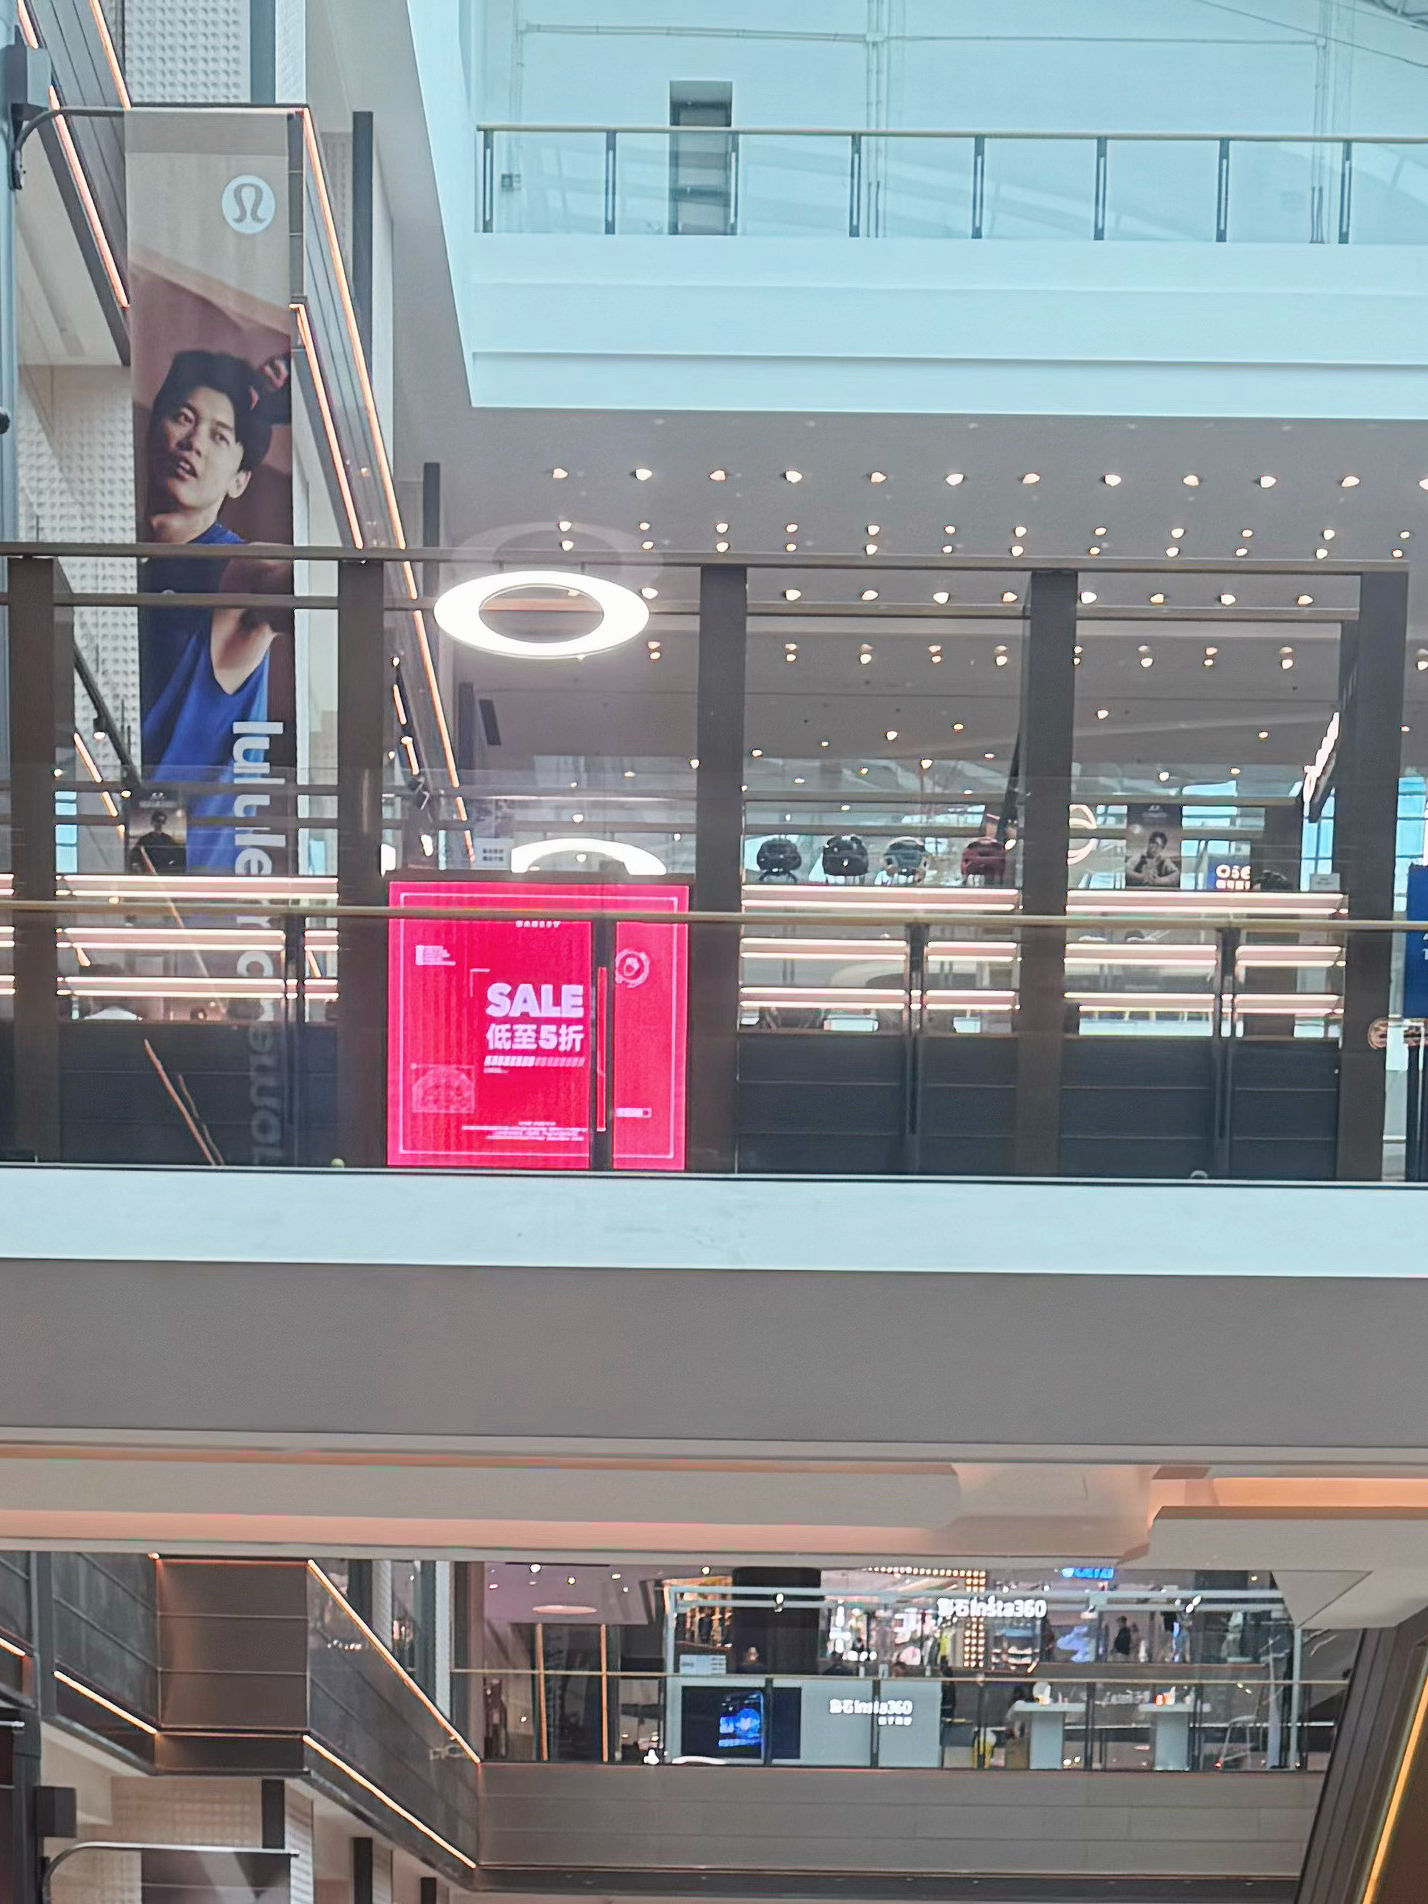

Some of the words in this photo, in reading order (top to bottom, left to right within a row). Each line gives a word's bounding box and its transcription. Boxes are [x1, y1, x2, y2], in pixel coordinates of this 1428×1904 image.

[486, 982, 584, 1017] SALE
[486, 1023, 584, 1052] 低至5折
